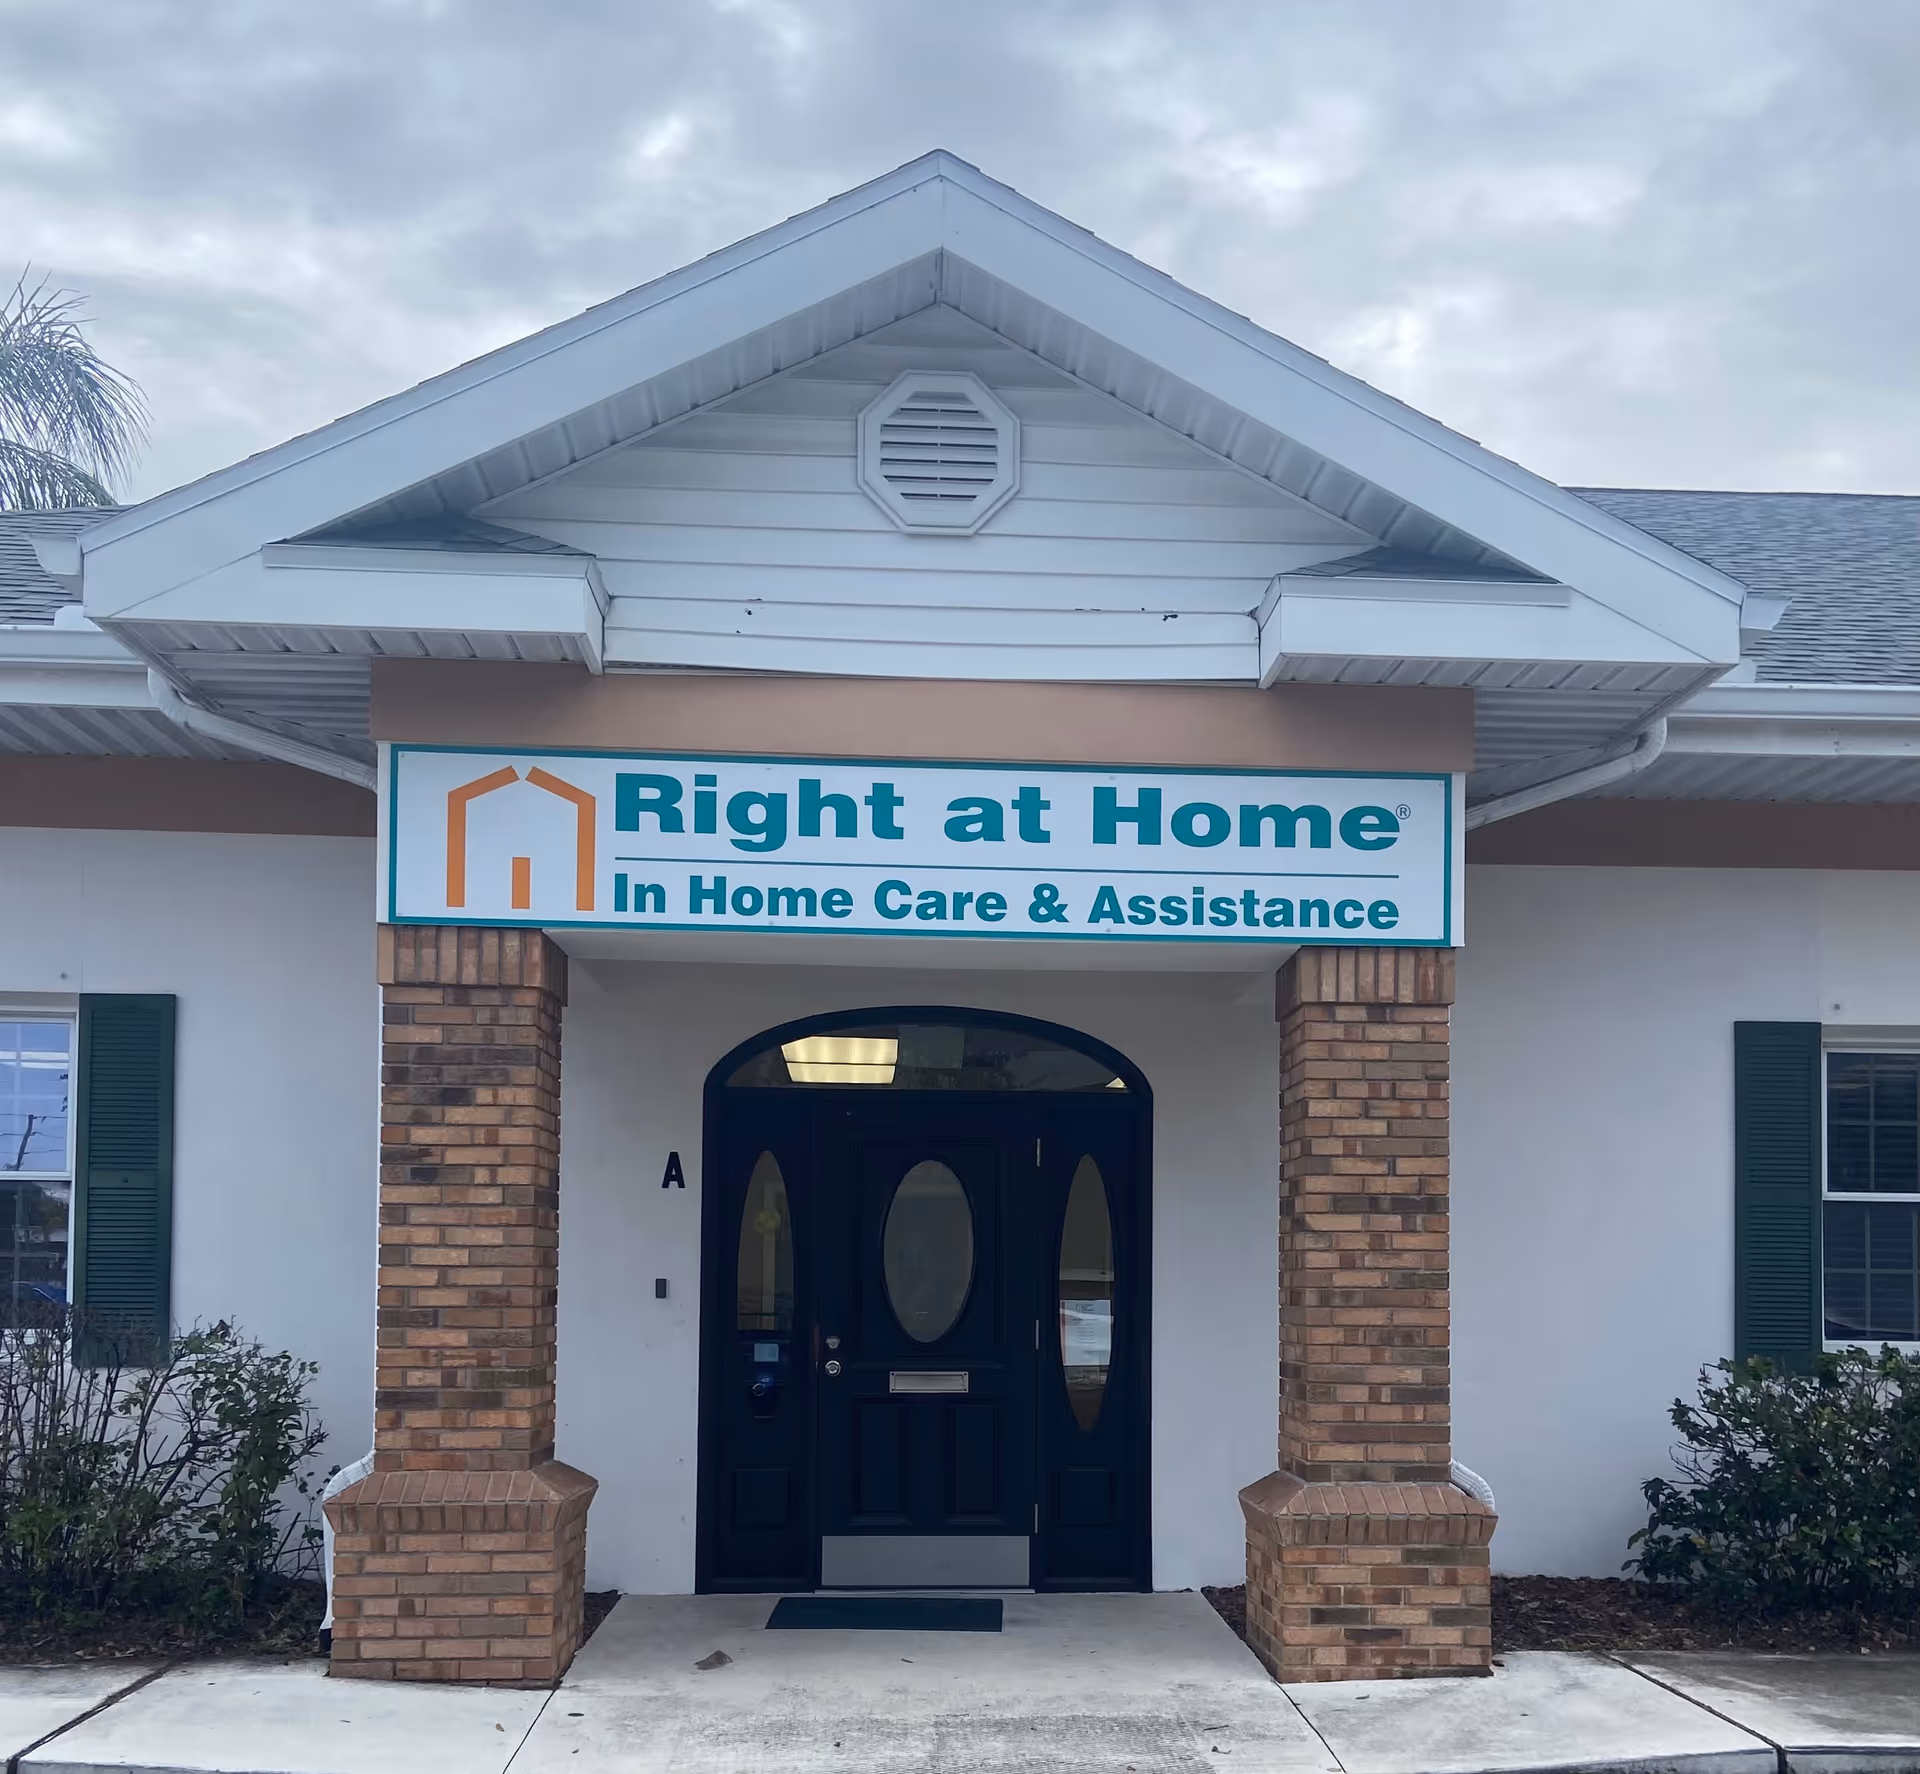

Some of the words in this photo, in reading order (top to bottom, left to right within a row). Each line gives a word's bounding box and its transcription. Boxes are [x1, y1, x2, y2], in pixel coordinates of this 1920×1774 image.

[614, 773, 905, 853] Right
[943, 785, 1051, 844] at
[613, 872, 666, 914] In
[688, 874, 854, 919] Home
[873, 879, 1008, 923] Care
[1028, 882, 1069, 924] &
[1087, 885, 1400, 930] Assistance
[661, 1151, 686, 1189] A
